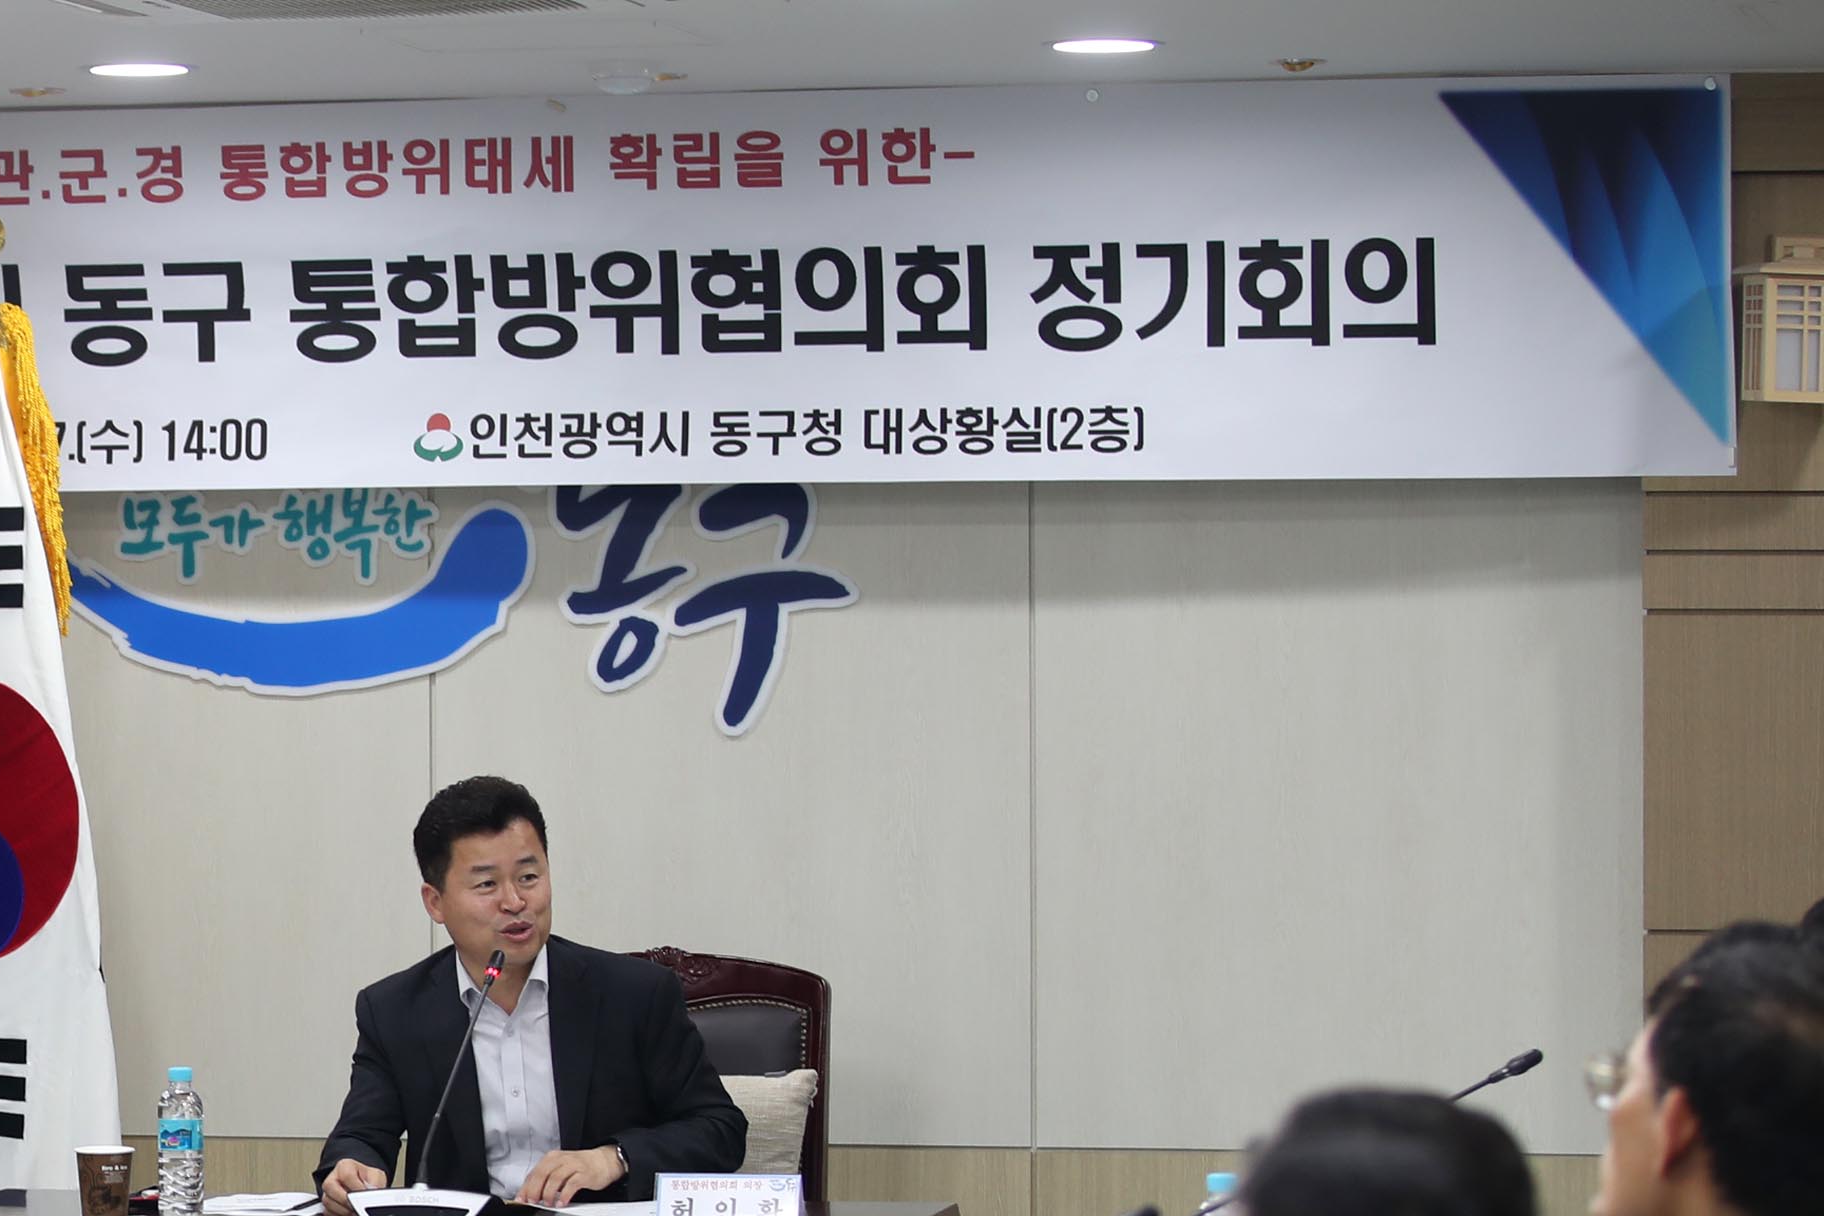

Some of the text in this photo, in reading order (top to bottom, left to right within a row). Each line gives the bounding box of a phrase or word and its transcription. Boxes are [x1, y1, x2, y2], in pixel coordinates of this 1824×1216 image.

[219, 134, 575, 201] 통합방위태세
[609, 130, 784, 190] 확립을
[63, 260, 252, 368] 동구
[289, 246, 988, 364] 통합방위협의회
[1029, 236, 1437, 353] 정기회의
[161, 417, 268, 463] 14:00
[469, 404, 1145, 460] 인천광역시 동구청 대상황실(2층)
[120, 492, 261, 578] 모두가
[274, 486, 436, 580] 행복한
